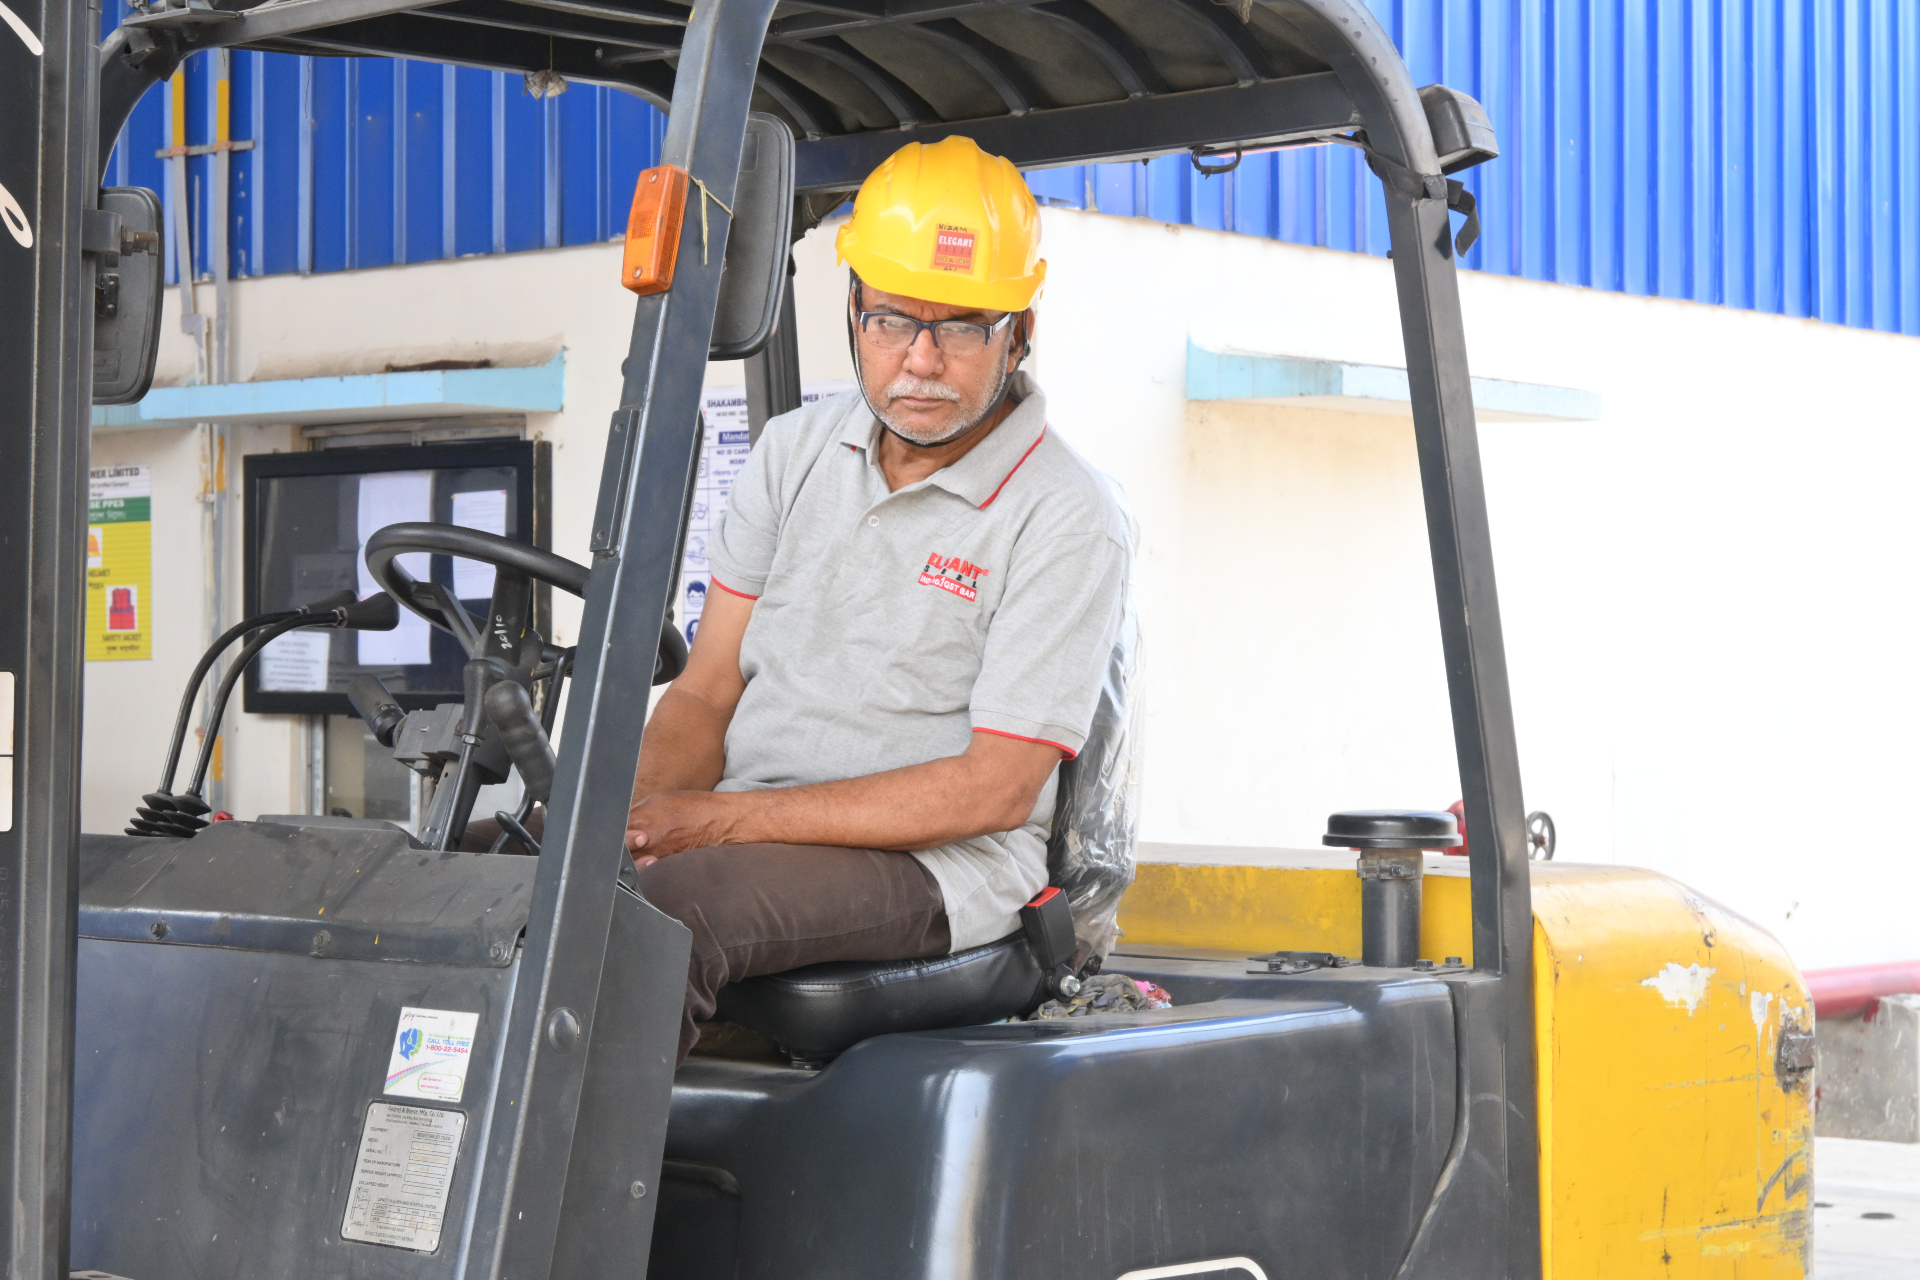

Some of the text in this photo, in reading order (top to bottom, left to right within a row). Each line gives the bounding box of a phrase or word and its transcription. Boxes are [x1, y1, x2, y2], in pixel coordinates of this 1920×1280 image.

[939, 236, 973, 247] ELEGANT
[707, 398, 747, 408] SHAKAMBH
[802, 394, 818, 402] WER
[722, 432, 749, 441] Mandat
[90, 467, 140, 478] WER LIMITED
[960, 588, 975, 600] BAR
[426, 1045, 468, 1053] 1-800-22-5454
